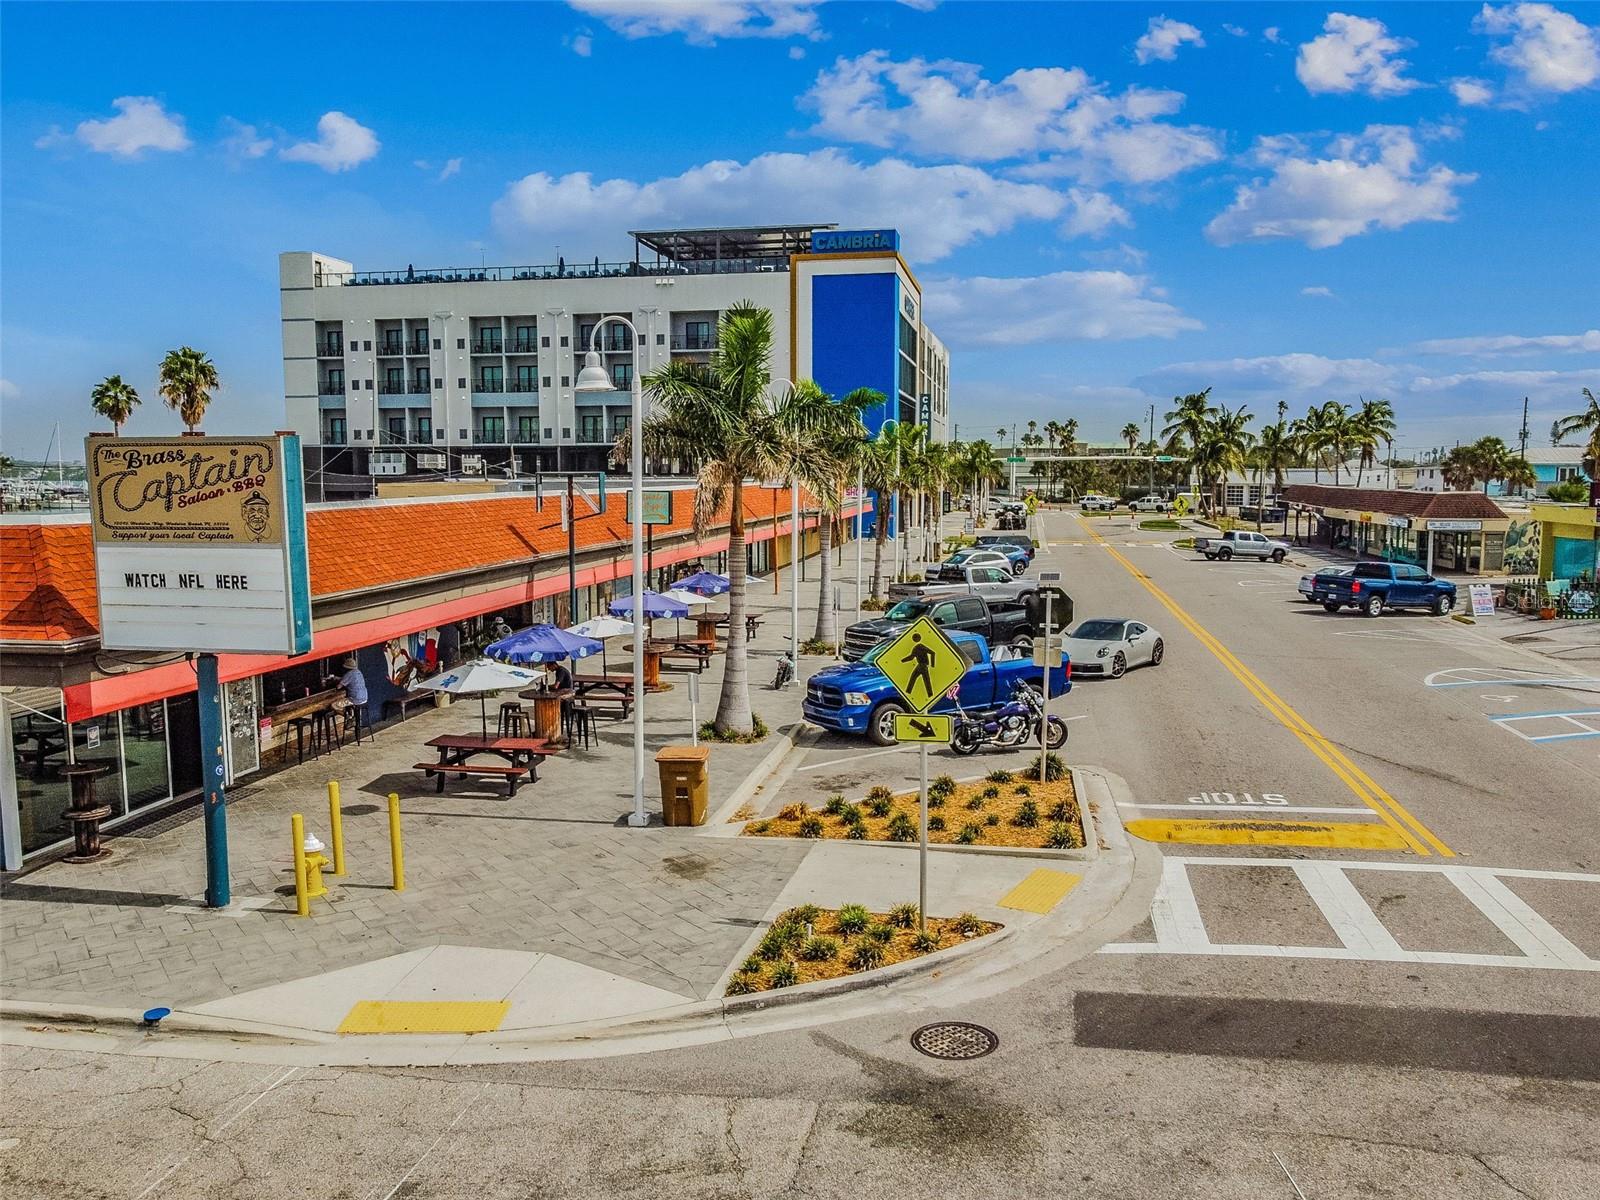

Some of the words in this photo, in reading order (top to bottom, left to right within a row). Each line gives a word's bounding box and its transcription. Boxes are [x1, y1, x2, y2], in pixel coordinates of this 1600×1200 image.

[100, 449, 121, 459] The
[122, 449, 185, 469] Brass
[111, 448, 272, 512] Captain
[177, 488, 225, 508] Saloon
[232, 474, 266, 492] BBQ
[111, 531, 147, 540] Support
[149, 533, 170, 541] your
[172, 531, 195, 539] local
[198, 531, 234, 541] Captain
[124, 573, 167, 588] WATCH
[179, 574, 205, 588] NFL
[216, 574, 248, 590] HERE
[1187, 791, 1289, 807] STOP
